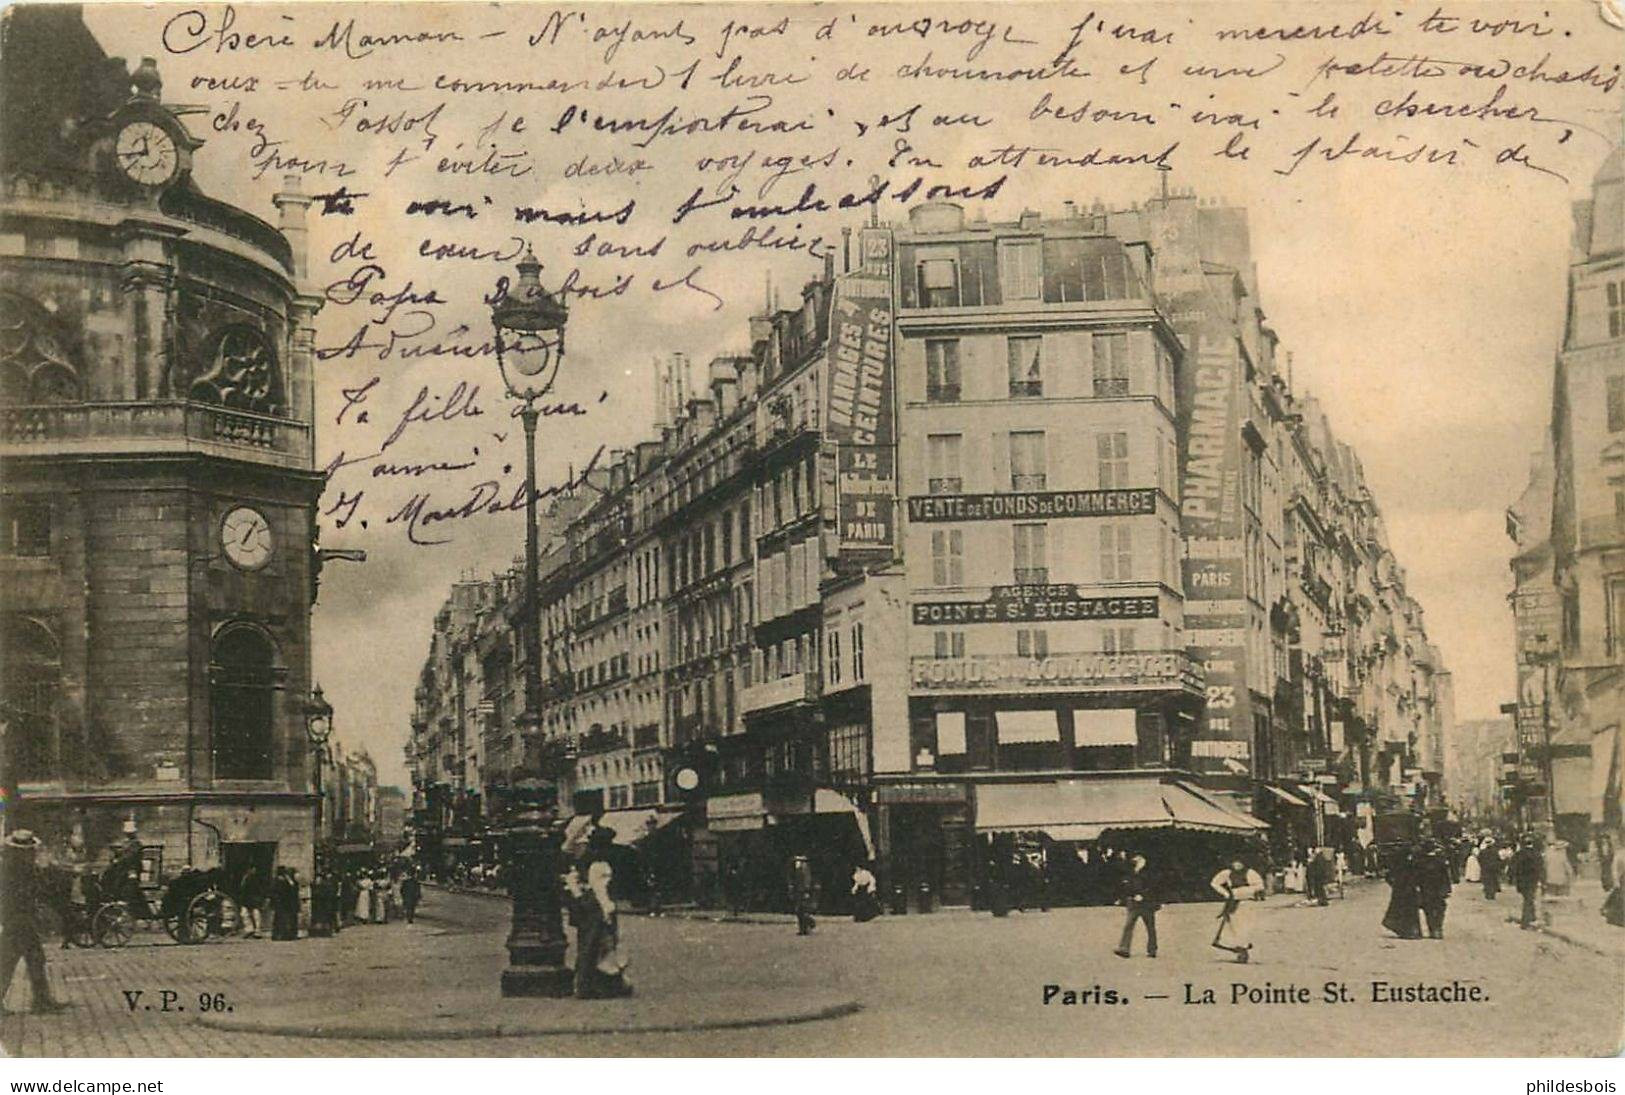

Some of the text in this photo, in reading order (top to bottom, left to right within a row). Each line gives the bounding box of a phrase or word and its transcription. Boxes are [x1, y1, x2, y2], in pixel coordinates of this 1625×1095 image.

[314, 19, 464, 59] Maman
[716, 16, 791, 58] pas
[364, 75, 419, 92] me
[837, 63, 871, 84] de
[331, 232, 377, 263] de
[852, 308, 891, 445] CEINTURES
[1183, 334, 1234, 520] PHARMACIE
[912, 498, 965, 518] VENTE
[983, 495, 1038, 516] FONDS
[1039, 501, 1053, 514] DE
[1054, 491, 1153, 513] COMMERCE
[1000, 586, 1070, 598] AGENCE
[1192, 571, 1232, 588] PARIS
[916, 604, 997, 621] POINTE
[1034, 599, 1154, 618] EUSTACHE
[1205, 686, 1236, 709] 23
